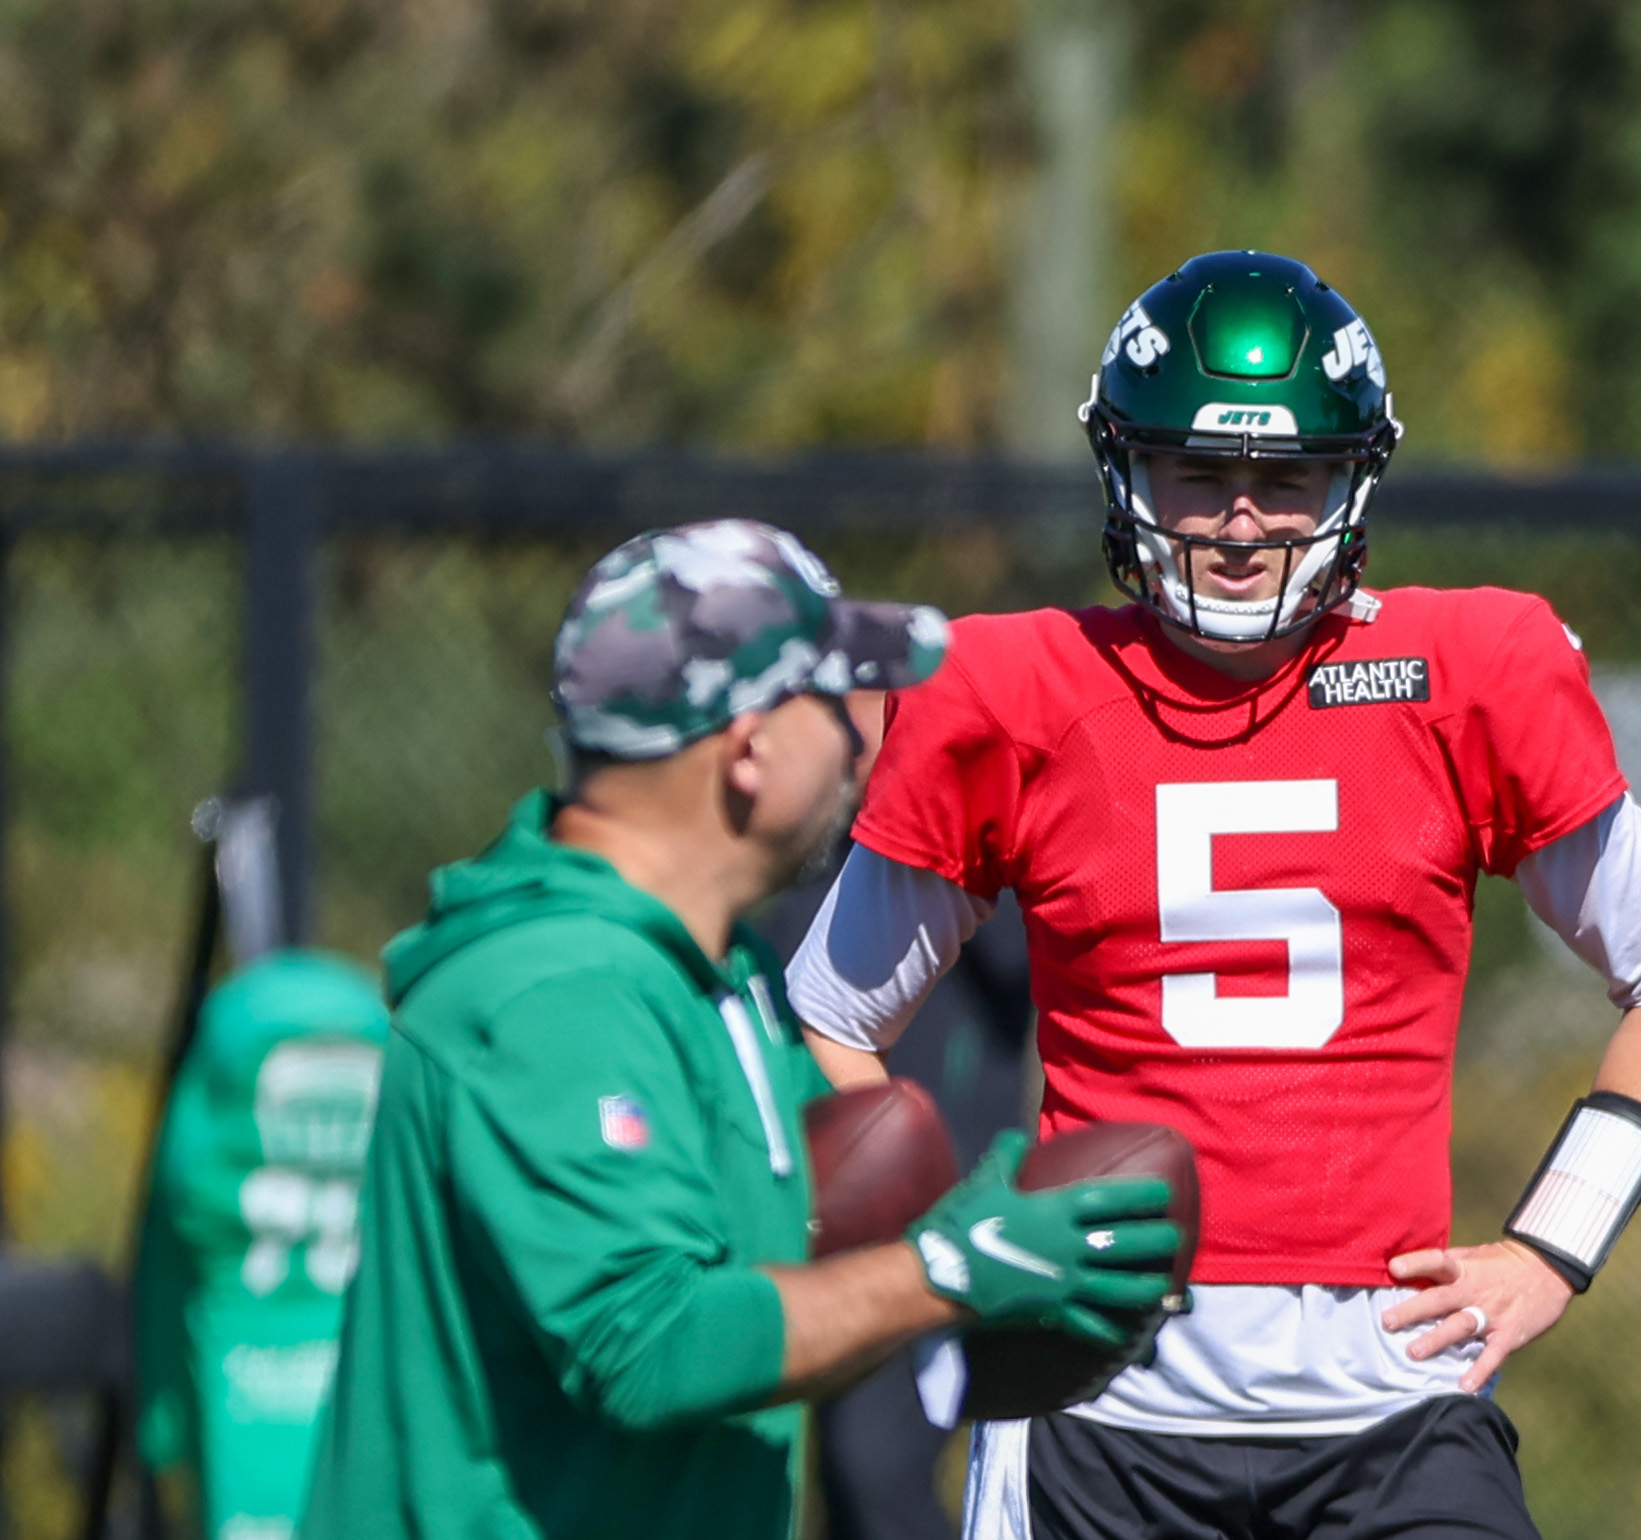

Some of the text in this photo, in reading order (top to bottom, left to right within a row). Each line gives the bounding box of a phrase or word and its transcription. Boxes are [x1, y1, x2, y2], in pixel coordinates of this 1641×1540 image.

[1217, 410, 1272, 427] JETS
[1308, 660, 1424, 688] ATLANTIC
[1324, 677, 1412, 704] HEALTH
[1155, 778, 1344, 1050] 5
